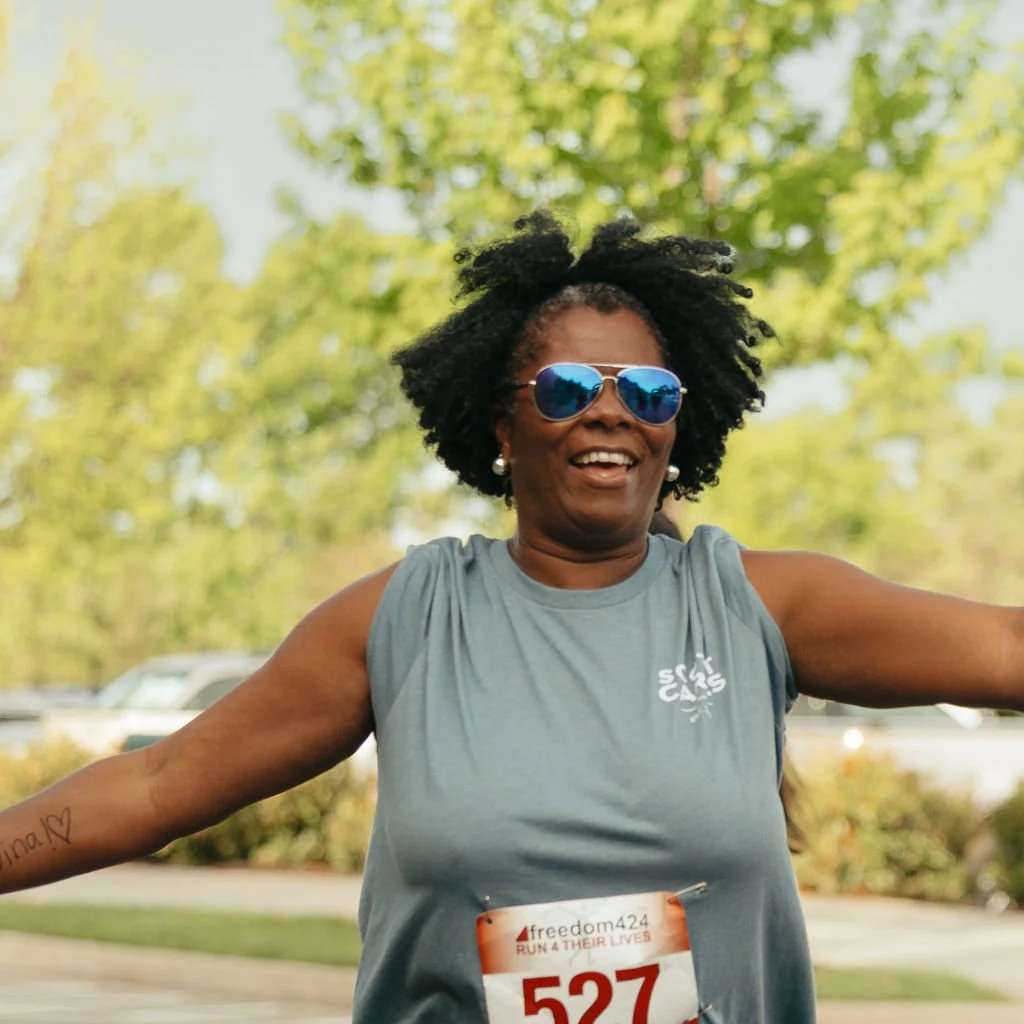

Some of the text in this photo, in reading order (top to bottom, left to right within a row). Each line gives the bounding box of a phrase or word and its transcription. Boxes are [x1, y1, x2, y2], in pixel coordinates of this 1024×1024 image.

[516, 930, 652, 956] RUN 4 THEIR LIVES
